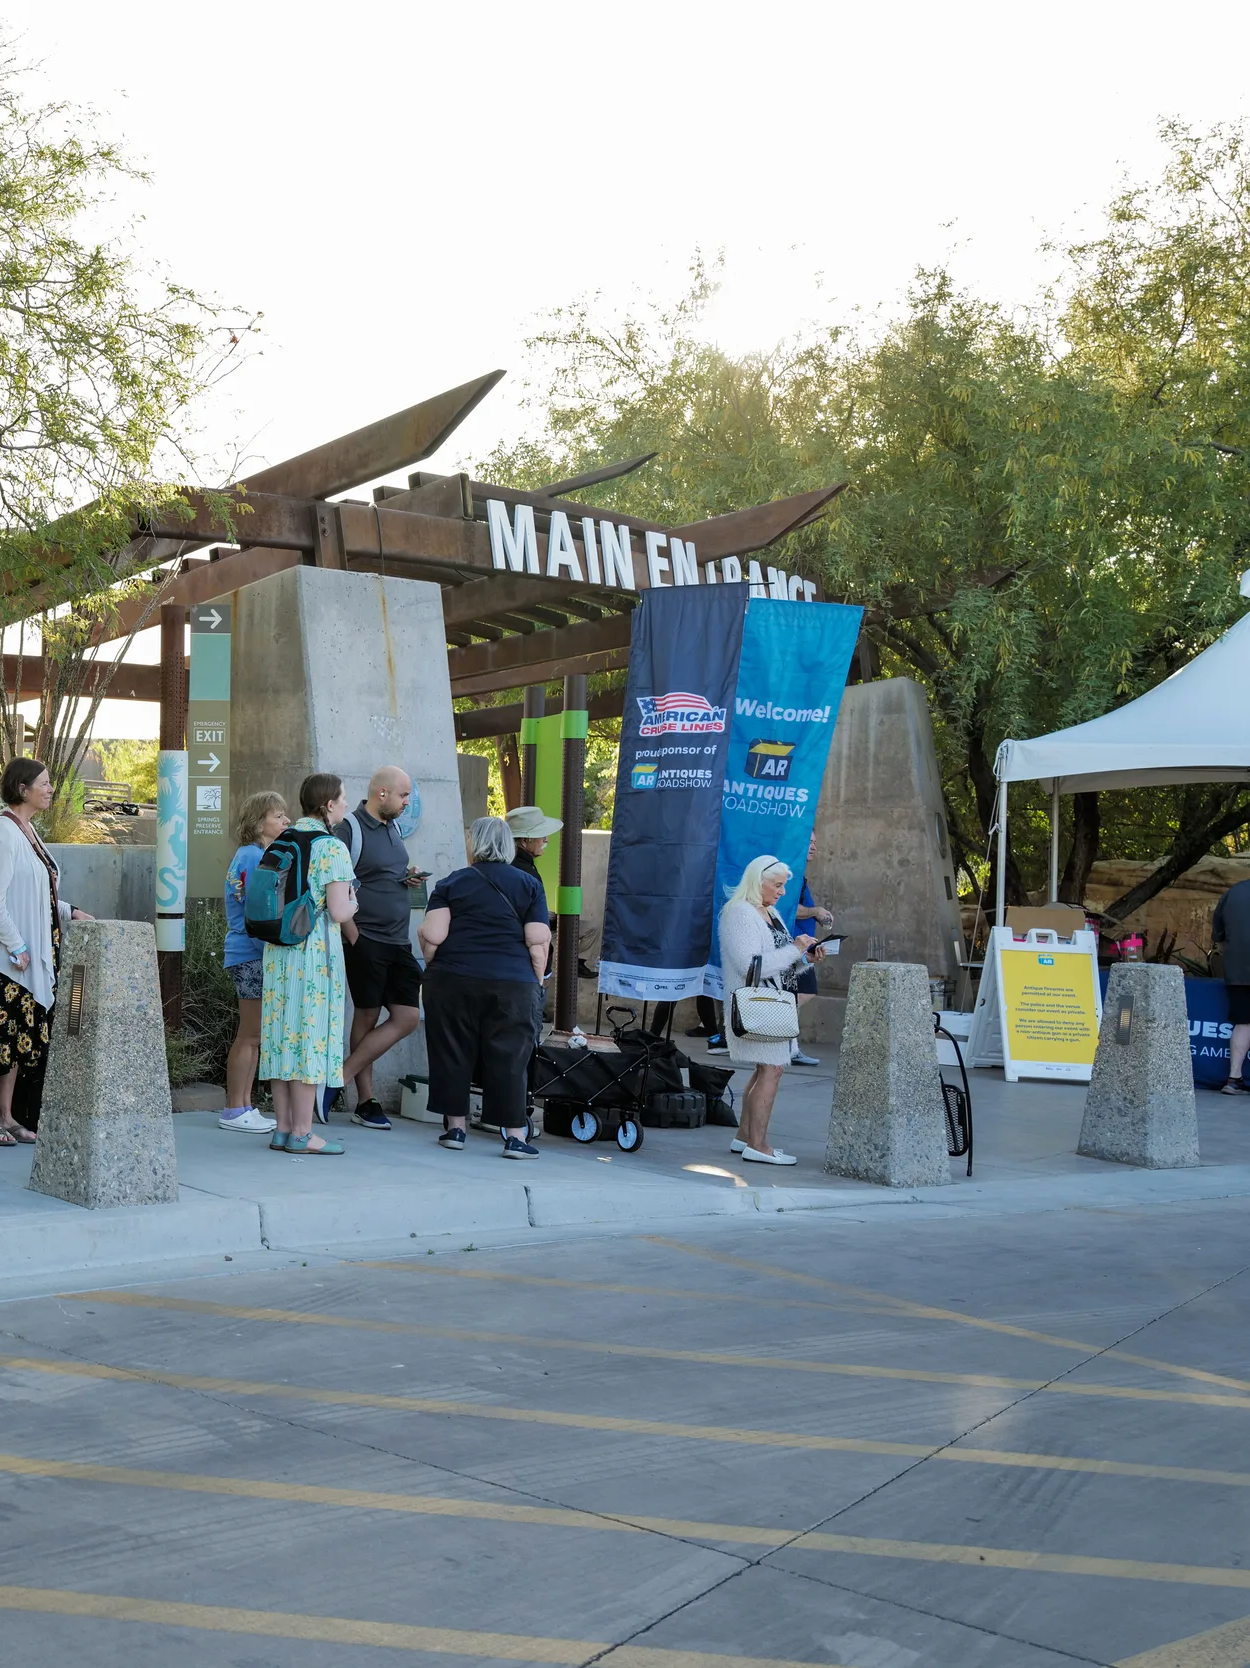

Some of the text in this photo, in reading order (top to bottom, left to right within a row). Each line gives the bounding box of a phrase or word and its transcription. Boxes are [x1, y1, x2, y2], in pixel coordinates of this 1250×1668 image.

[486, 499, 635, 590] MAIN
[642, 710, 725, 726] AMERICAN
[735, 697, 831, 723] Welcome!
[196, 730, 224, 742] EXIT
[641, 722, 723, 735] CRUSE LINES
[704, 745, 717, 755] of
[761, 759, 788, 776] AR
[637, 774, 655, 786] AR
[722, 796, 806, 818] OADSHOW
